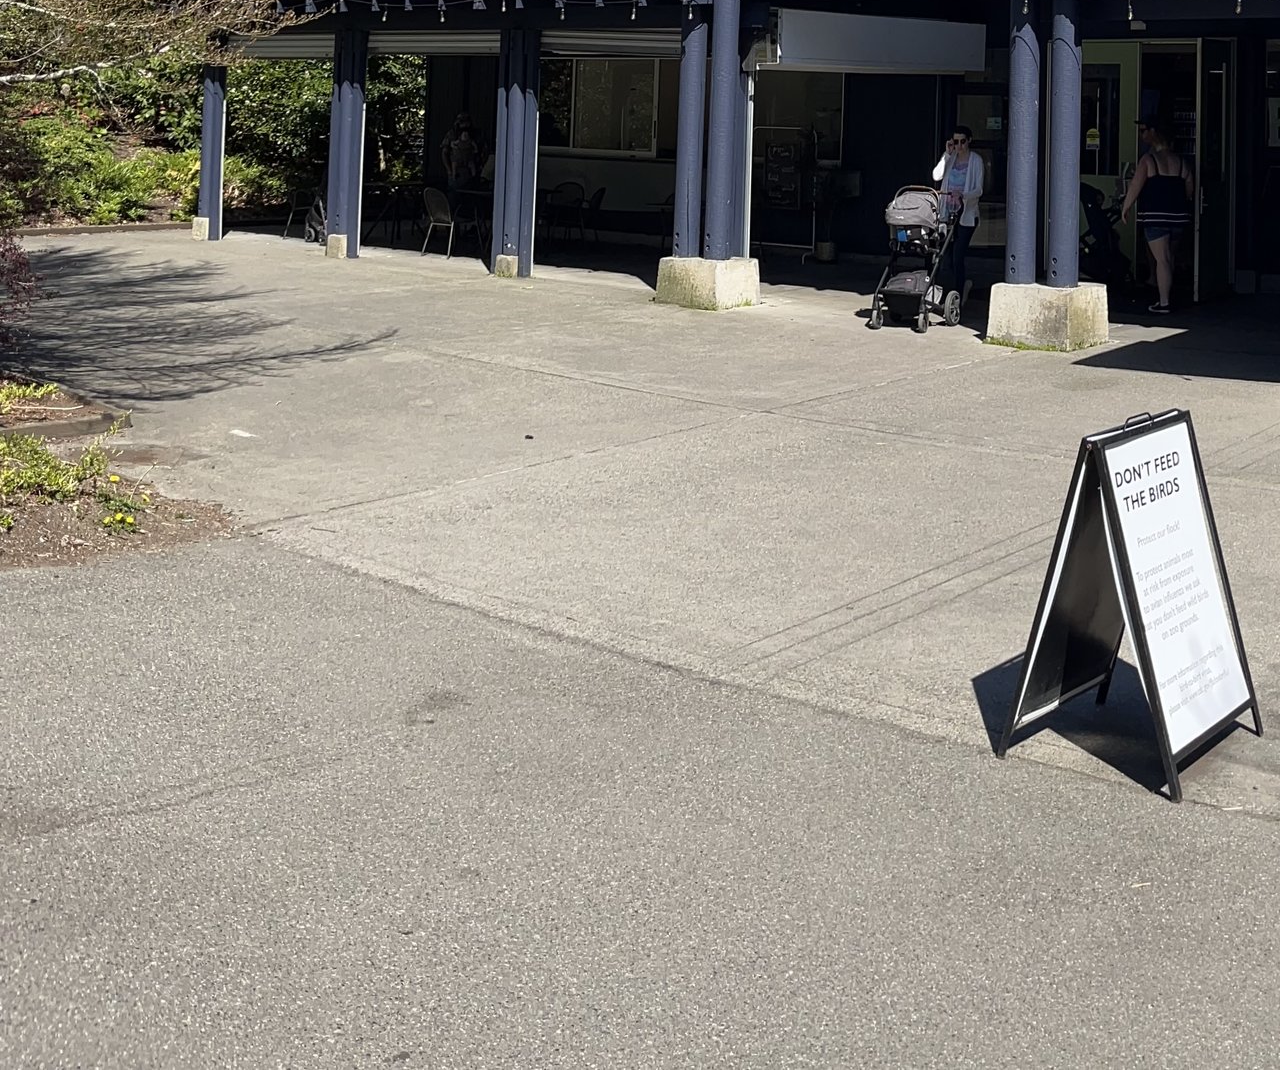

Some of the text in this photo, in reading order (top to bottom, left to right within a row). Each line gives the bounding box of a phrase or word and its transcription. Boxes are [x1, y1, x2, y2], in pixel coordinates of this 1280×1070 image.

[1114, 451, 1180, 488] DON'T FEED
[1123, 477, 1180, 512] THE BIRDS
[1137, 532, 1157, 548] Protect
[1157, 528, 1166, 539] our
[1136, 548, 1194, 583] To protect animals most
[1143, 565, 1194, 597] at risk from exposure
[1143, 576, 1201, 615] to avian influenza we ask
[1152, 616, 1163, 631] you
[1163, 607, 1176, 622] don't
[1176, 600, 1187, 615] feed
[1187, 594, 1198, 608] wild
[1197, 589, 1209, 602] birds
[1161, 630, 1170, 641] on
[1169, 625, 1179, 636] zoo
